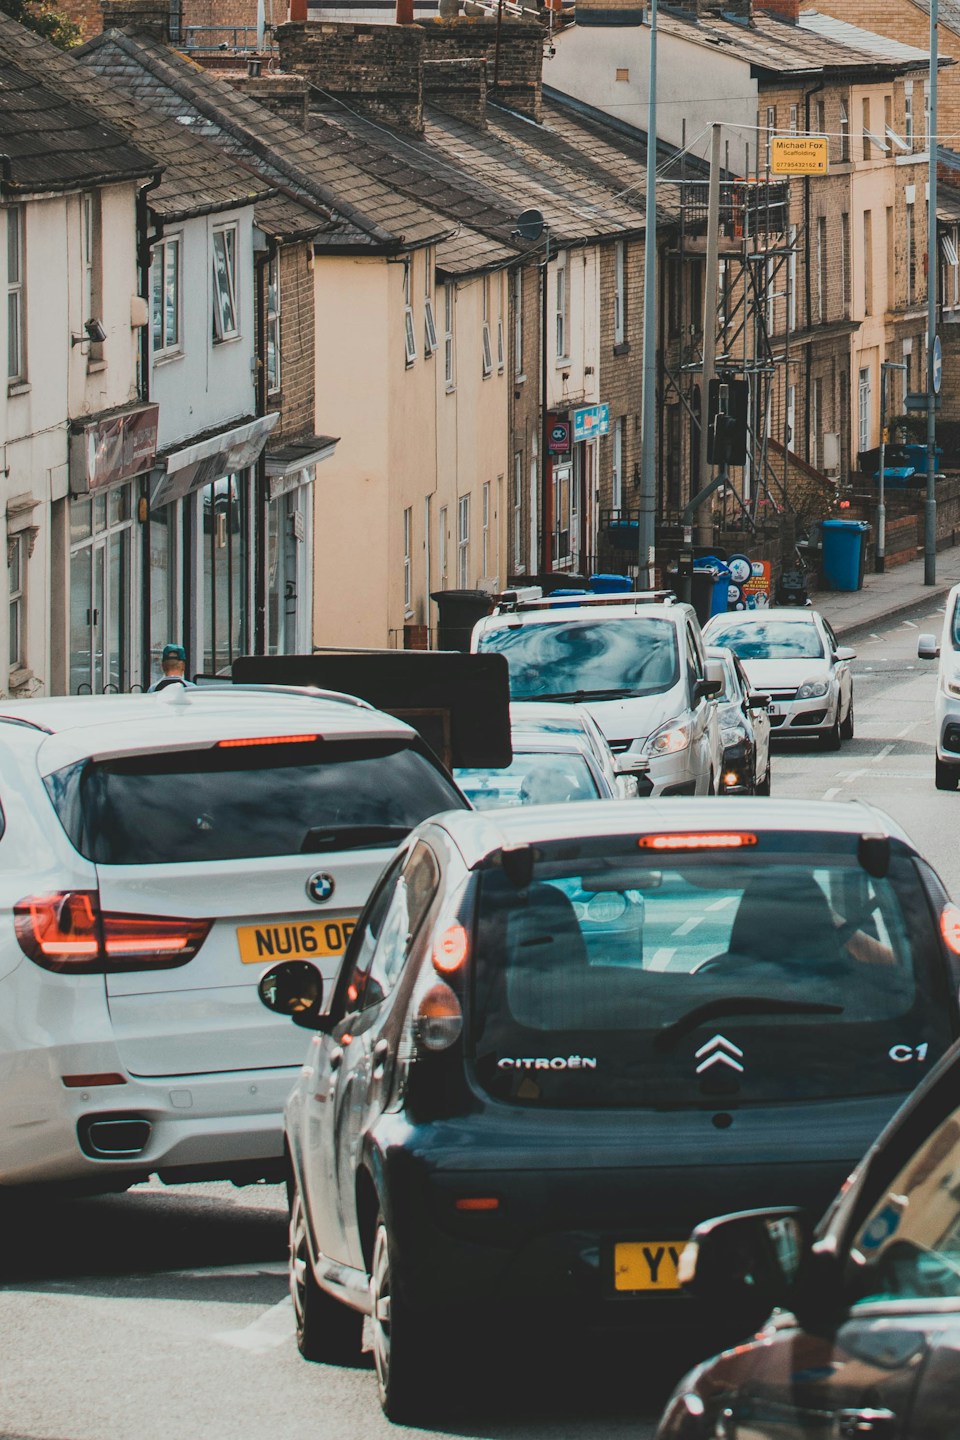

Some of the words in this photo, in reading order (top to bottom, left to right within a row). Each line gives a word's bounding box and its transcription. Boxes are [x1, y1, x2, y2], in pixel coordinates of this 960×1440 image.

[255, 925, 319, 956] NU16
[497, 1055, 597, 1069] CITROËN
[888, 1042, 929, 1062] C1
